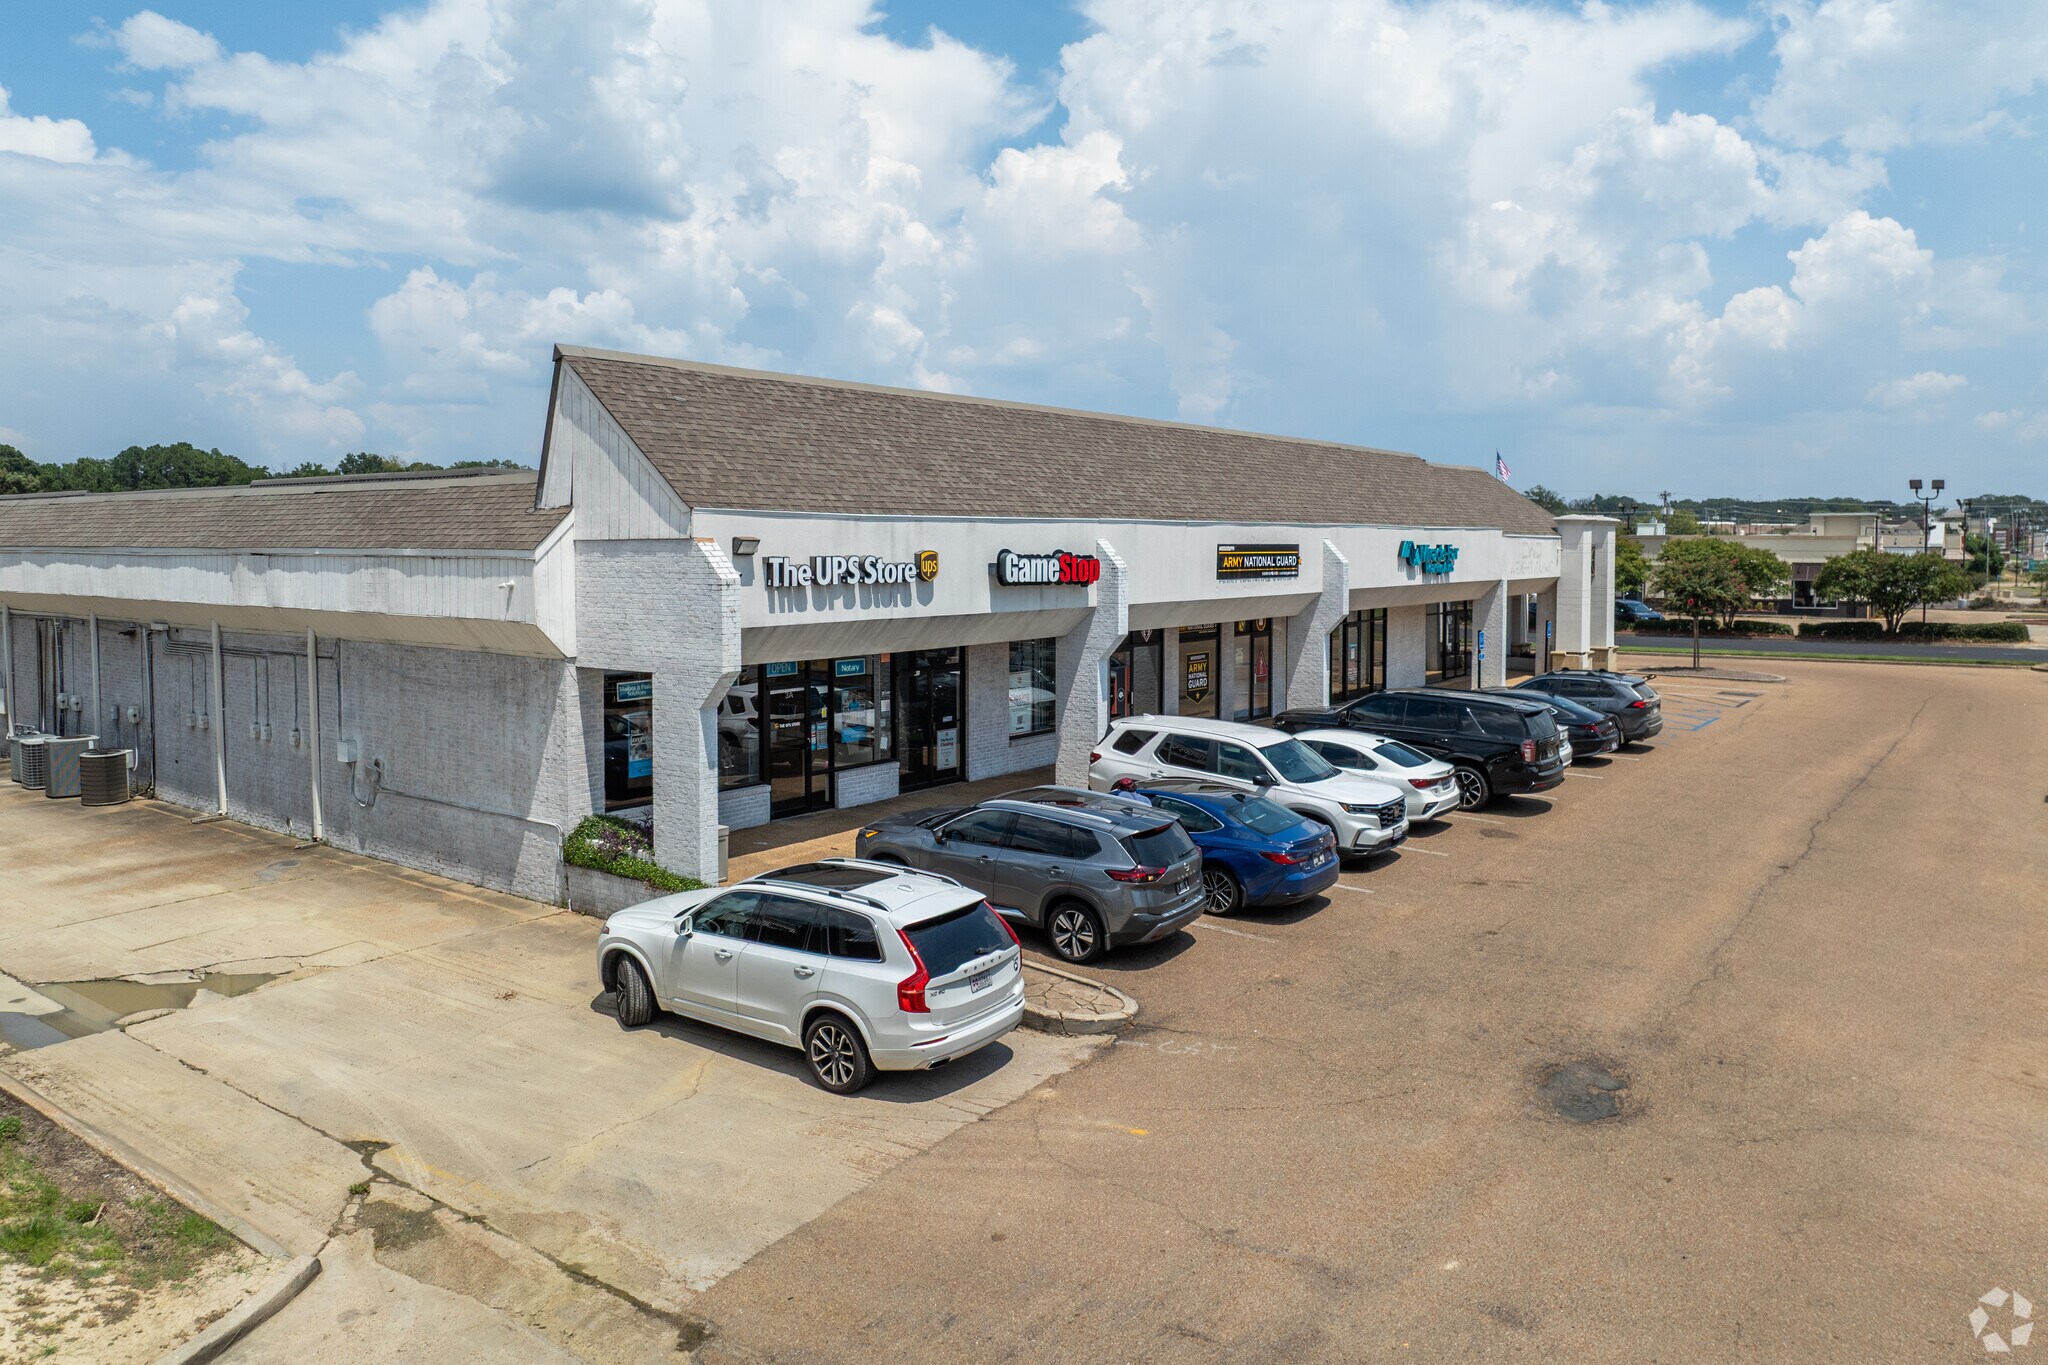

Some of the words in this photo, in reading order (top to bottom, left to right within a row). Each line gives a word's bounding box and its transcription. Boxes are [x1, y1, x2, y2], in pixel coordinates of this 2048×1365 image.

[1223, 556, 1243, 567] ARMY
[1244, 556, 1275, 567] NATIONAL
[1276, 555, 1297, 566] GUARD
[768, 557, 812, 587] The
[816, 555, 860, 585] UPS
[864, 555, 917, 585] Store
[922, 559, 937, 577] ups
[1006, 553, 1100, 584] GameStop
[771, 663, 791, 673] OPEN
[841, 663, 860, 673] Notary
[1188, 662, 1208, 673] ARMY
[1188, 678, 1208, 689] GUARD
[963, 955, 1002, 974] VOLVO
